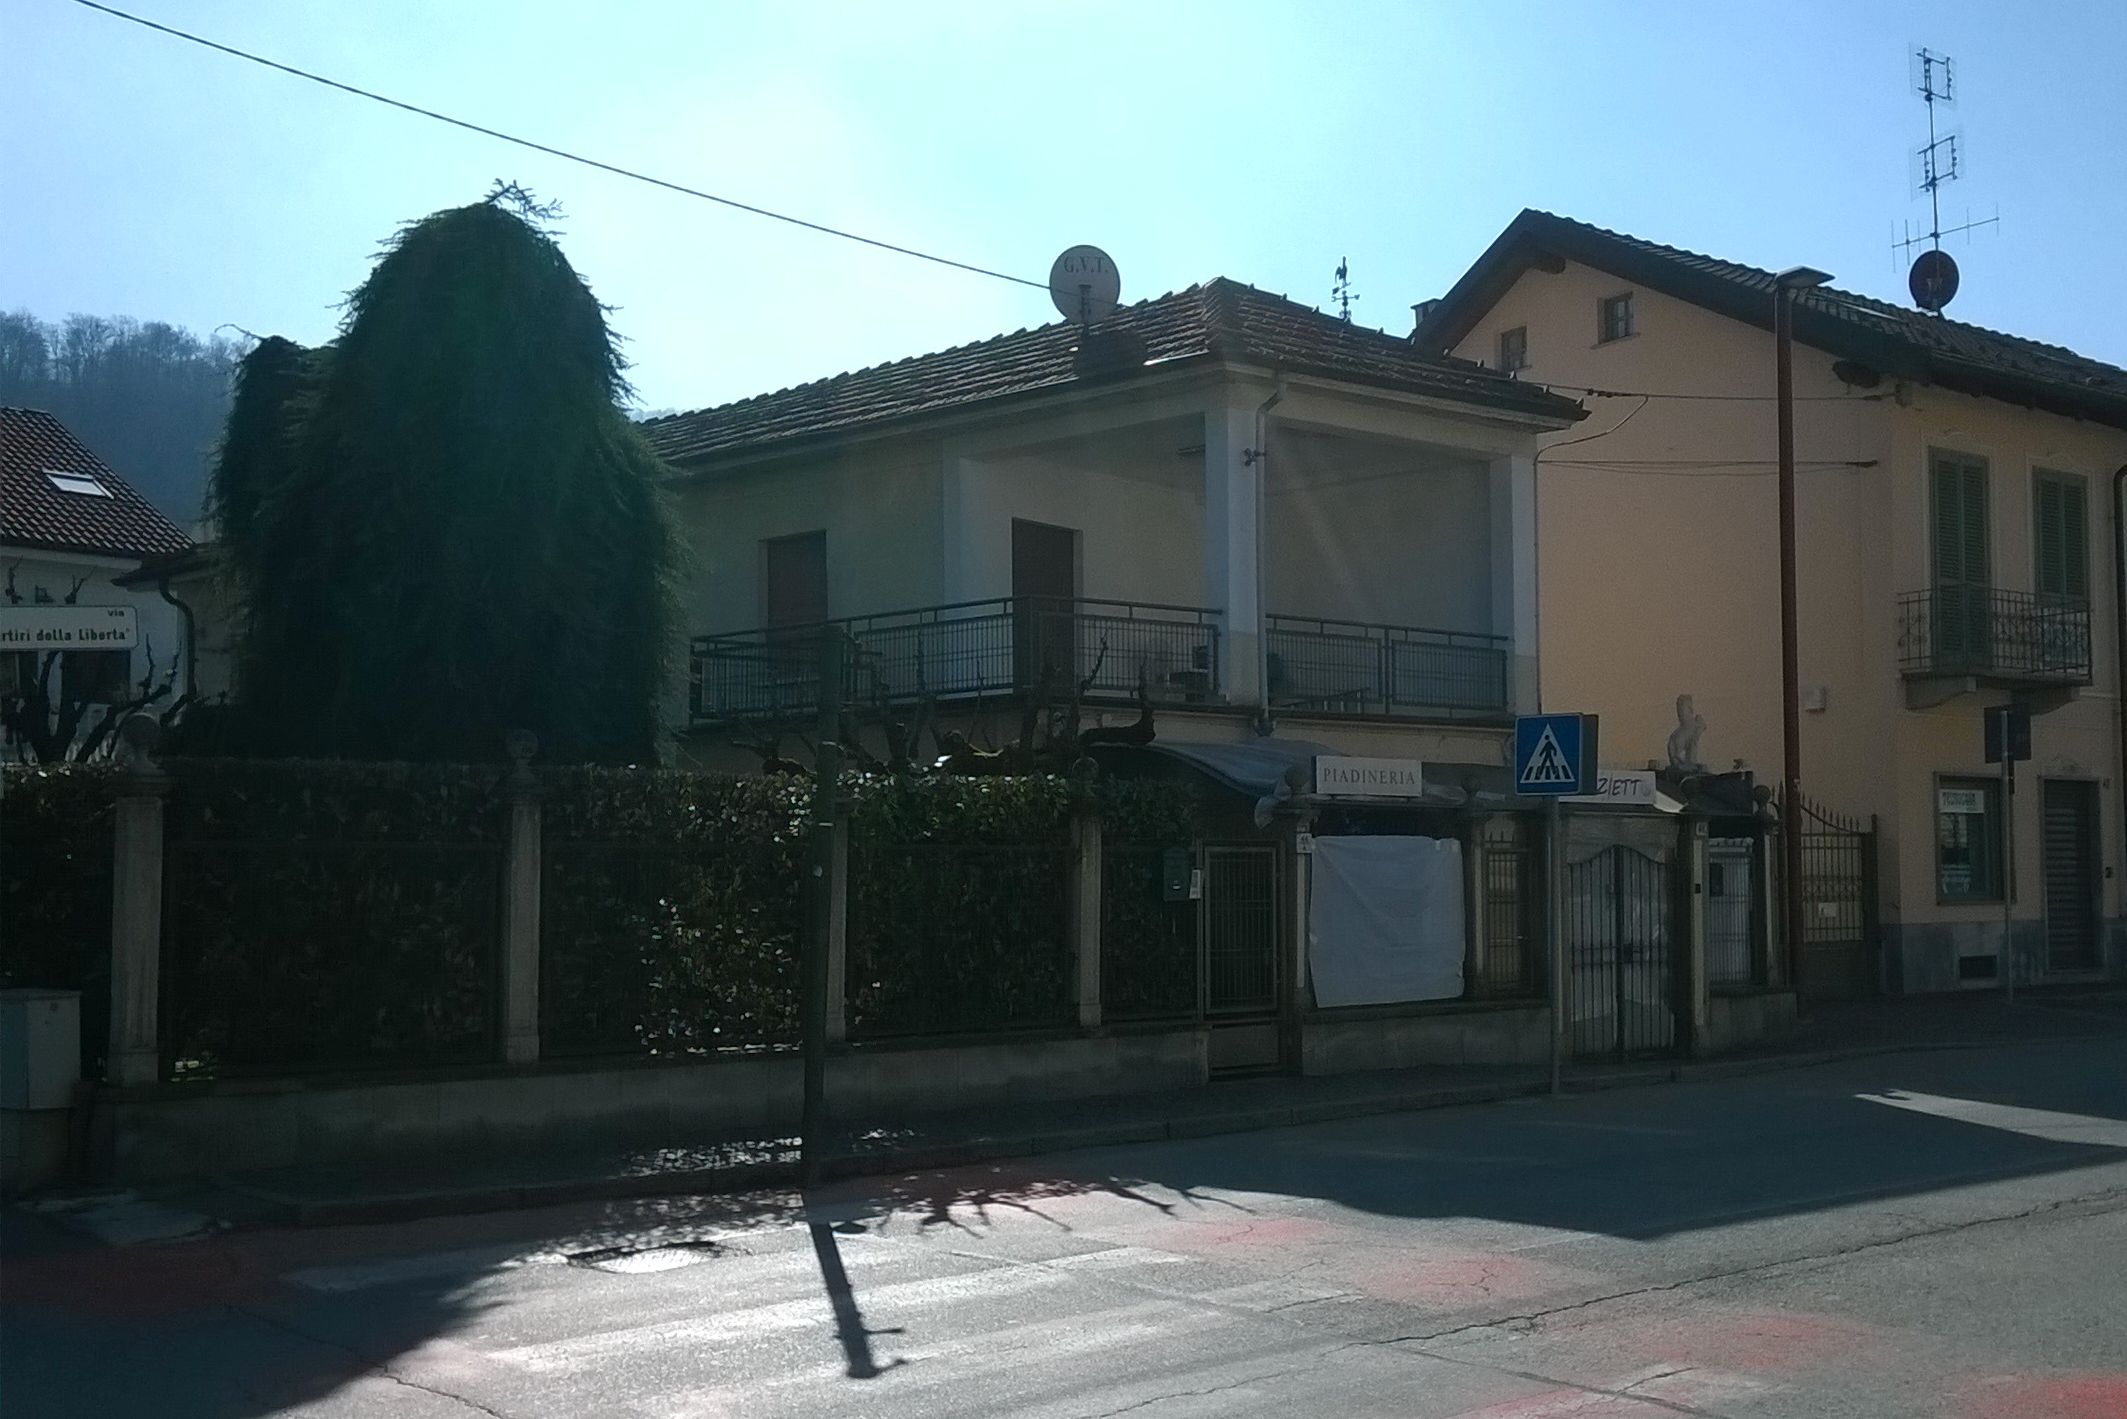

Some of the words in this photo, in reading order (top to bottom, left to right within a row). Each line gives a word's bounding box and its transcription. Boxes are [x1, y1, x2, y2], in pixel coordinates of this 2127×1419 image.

[107, 609, 125, 617] via
[1, 628, 30, 642] rtiri
[36, 628, 72, 641] della
[1323, 767, 1415, 785] PIADINERIA
